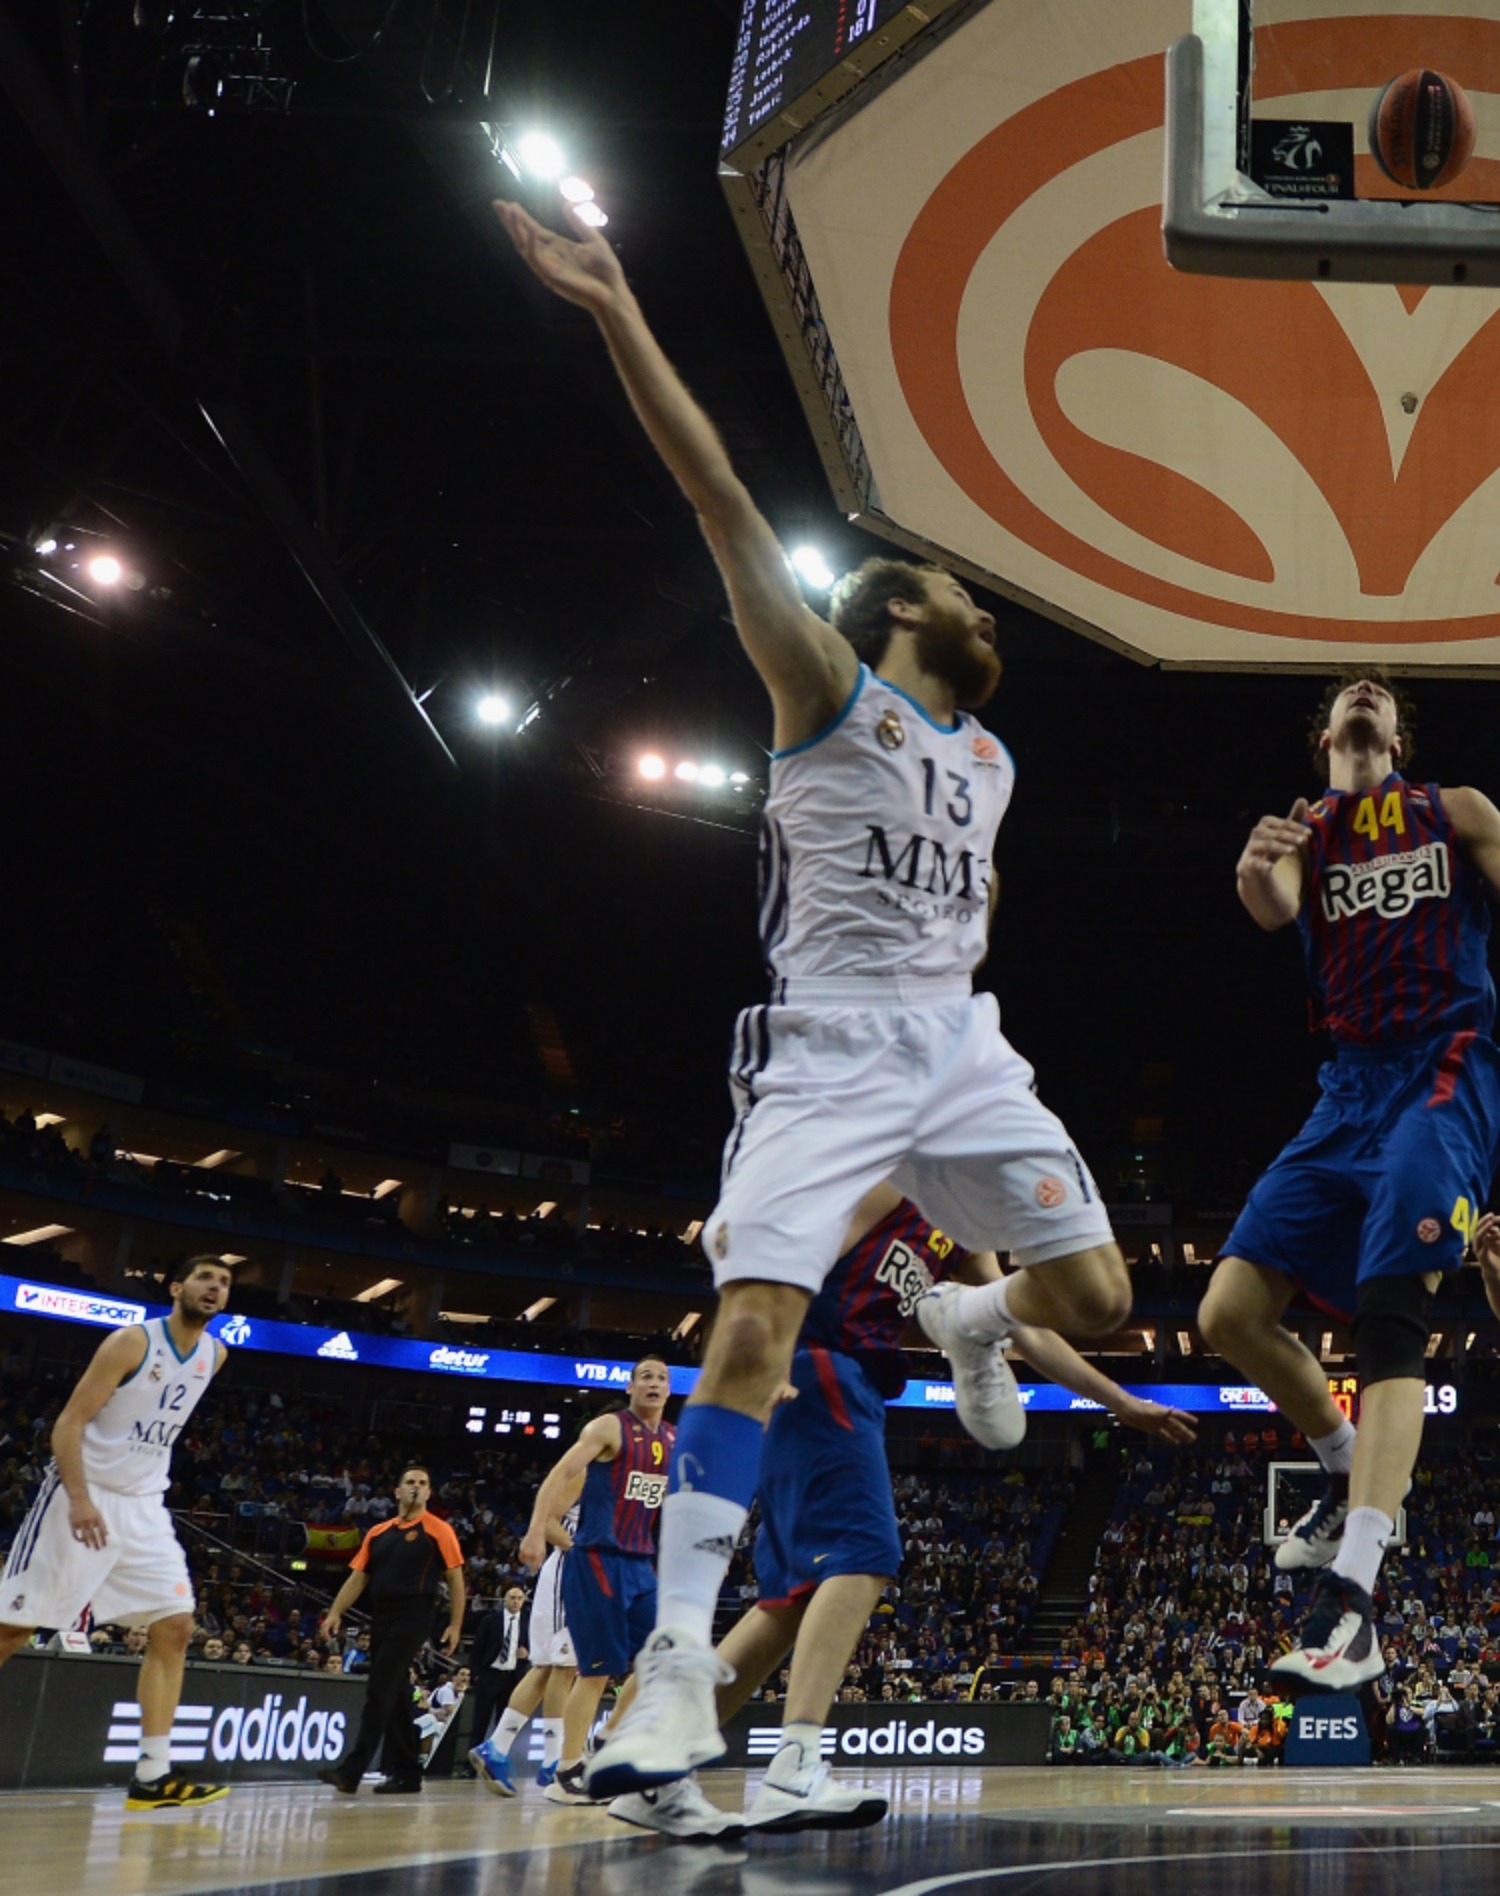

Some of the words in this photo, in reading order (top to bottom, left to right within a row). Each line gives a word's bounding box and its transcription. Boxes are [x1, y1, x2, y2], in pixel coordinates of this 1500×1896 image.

[921, 758, 973, 827] 13
[1353, 791, 1405, 841] 44
[1322, 846, 1449, 917] Regal
[41, 1293, 138, 1323] INTERSPORT
[429, 1346, 491, 1368] detur
[575, 1363, 607, 1380] VTB
[159, 1384, 187, 1411] 12
[652, 1441, 663, 1465] 9
[212, 1693, 347, 1762] adidas
[841, 1719, 985, 1755] adidas
[1299, 1716, 1359, 1740] EFES
